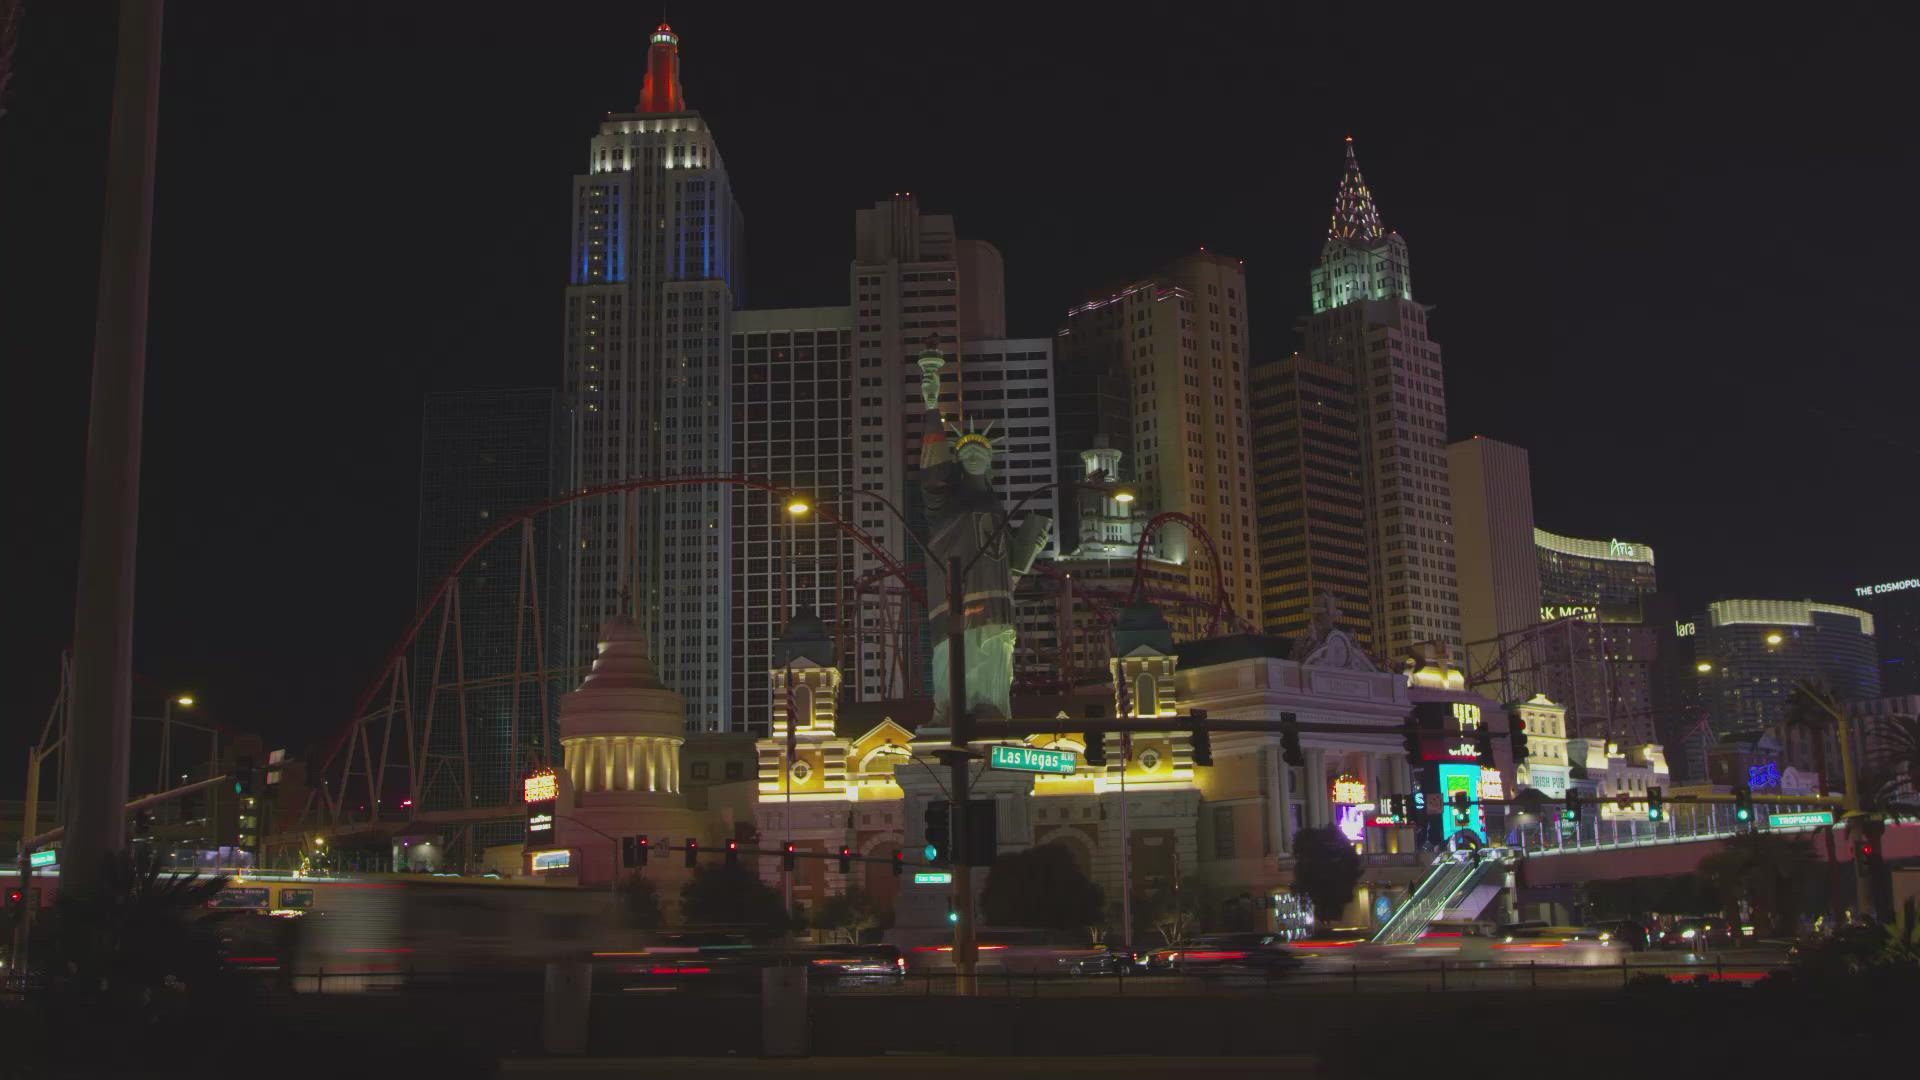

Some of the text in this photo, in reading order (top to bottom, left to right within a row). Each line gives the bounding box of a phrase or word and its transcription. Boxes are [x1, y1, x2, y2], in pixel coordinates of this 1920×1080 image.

[1610, 537, 1633, 557] Aria
[1855, 579, 1920, 596] THE COSMOPOL
[1559, 606, 1597, 620] MGM
[999, 747, 1020, 764] Las
[1023, 750, 1057, 770] Vegas
[1532, 775, 1565, 789] IRISH PUB
[1777, 815, 1822, 825] TROPICANA
